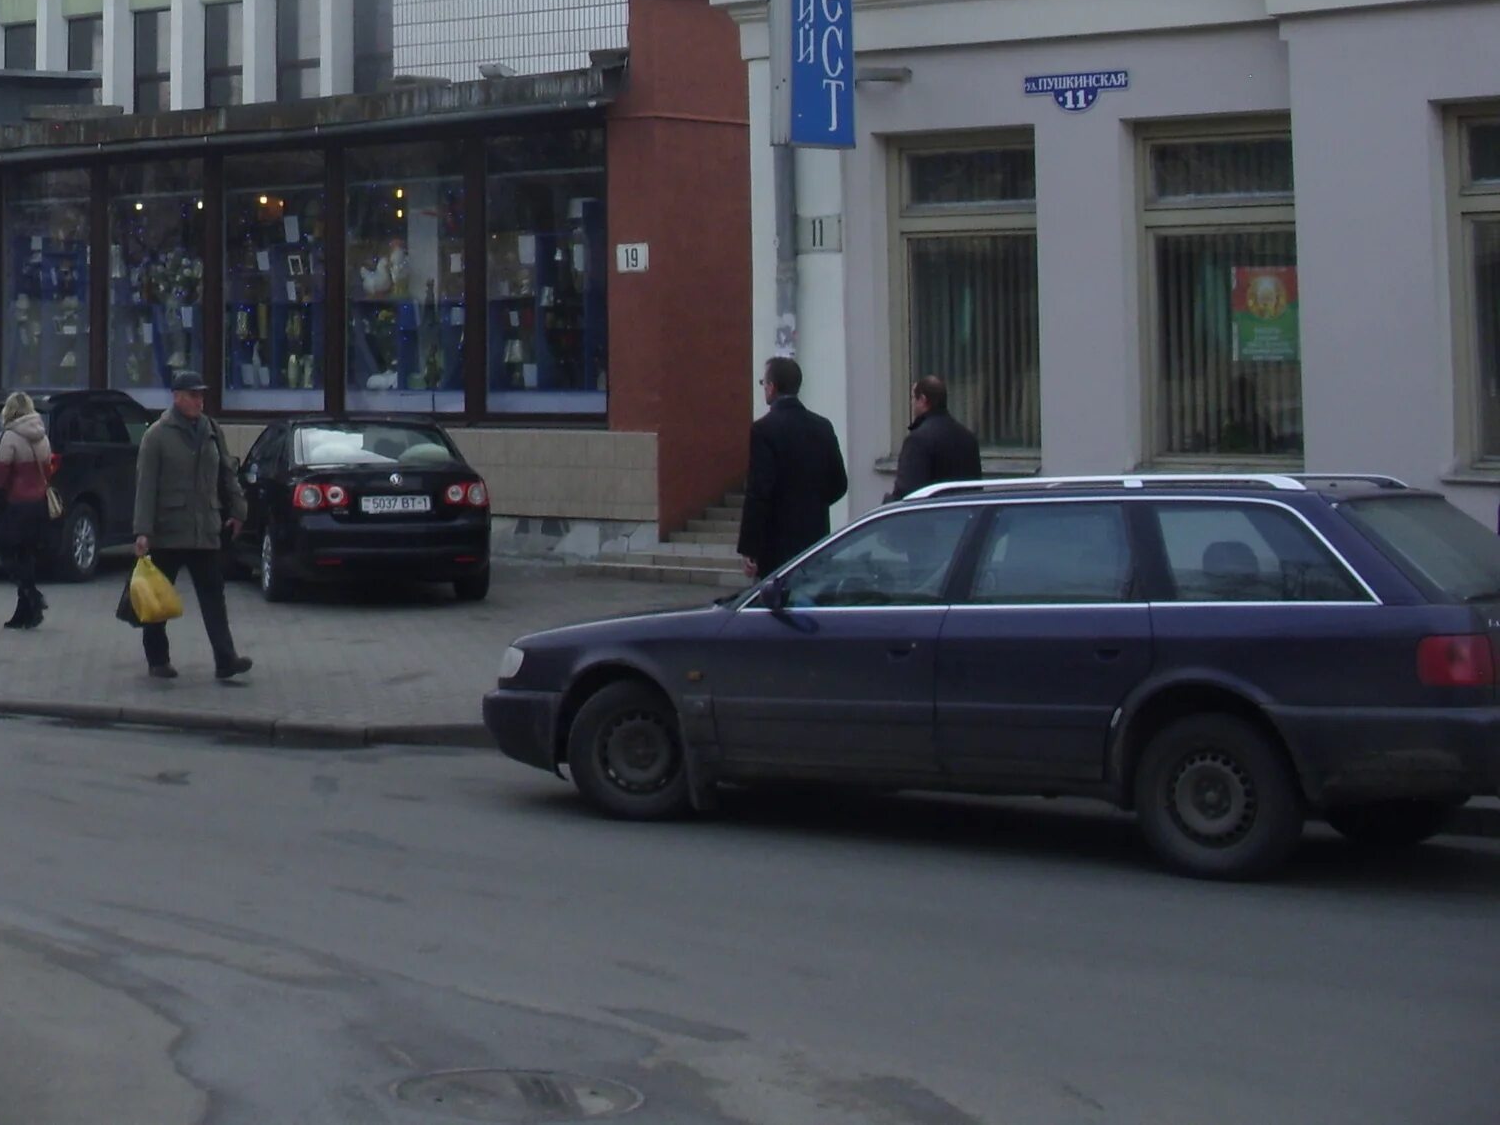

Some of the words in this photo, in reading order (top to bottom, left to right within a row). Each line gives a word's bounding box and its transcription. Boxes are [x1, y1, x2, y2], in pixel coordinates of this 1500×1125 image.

[1038, 72, 1126, 90] ПУШКИНСКАЯ
[1064, 90, 1087, 109] 11
[812, 219, 824, 247] 11
[624, 247, 639, 268] 19
[372, 497, 397, 509] 5037
[401, 496, 429, 509] BT-1
